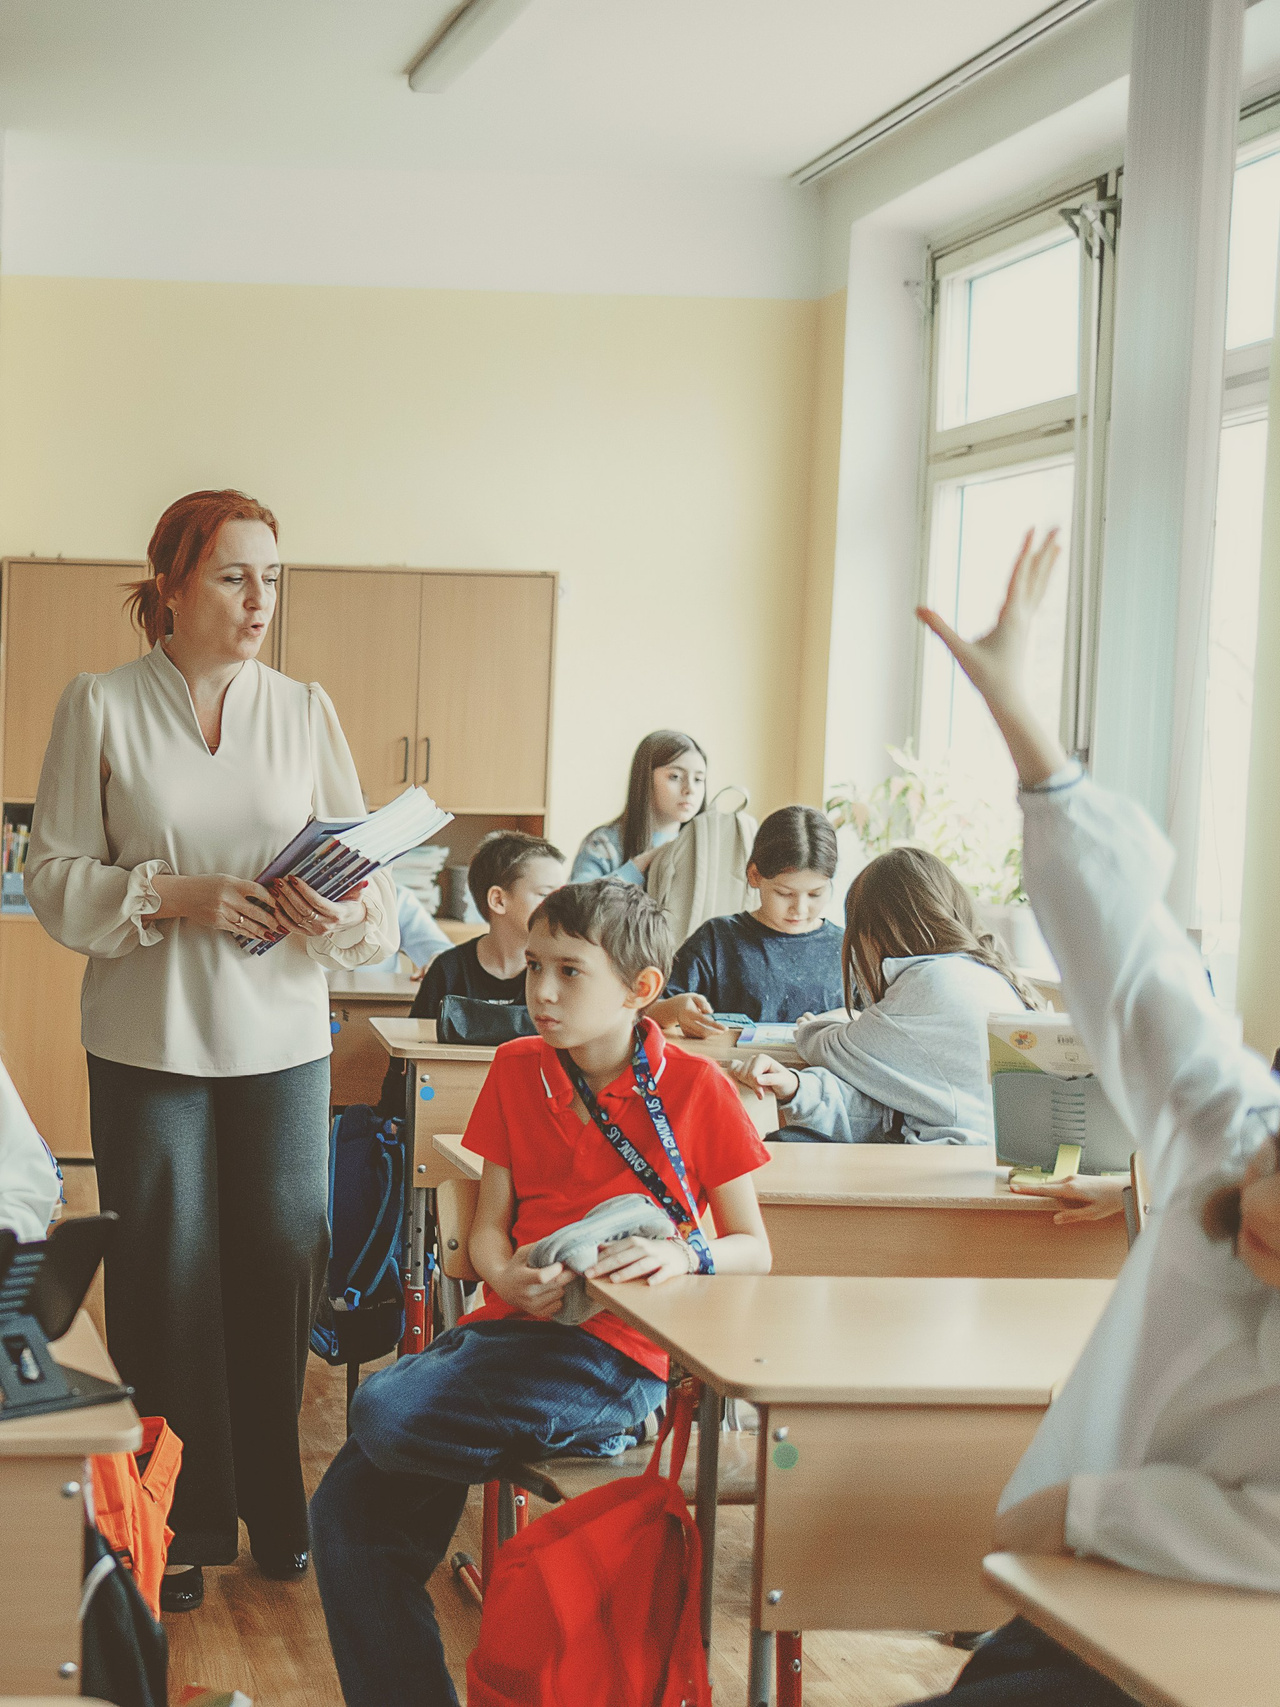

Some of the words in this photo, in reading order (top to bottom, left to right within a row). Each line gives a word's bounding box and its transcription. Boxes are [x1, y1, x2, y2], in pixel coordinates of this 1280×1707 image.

[646, 1098, 661, 1113] US
[606, 1126, 621, 1143] US
[652, 1114, 676, 1148] AMONG
[617, 1139, 647, 1172] AMONG
